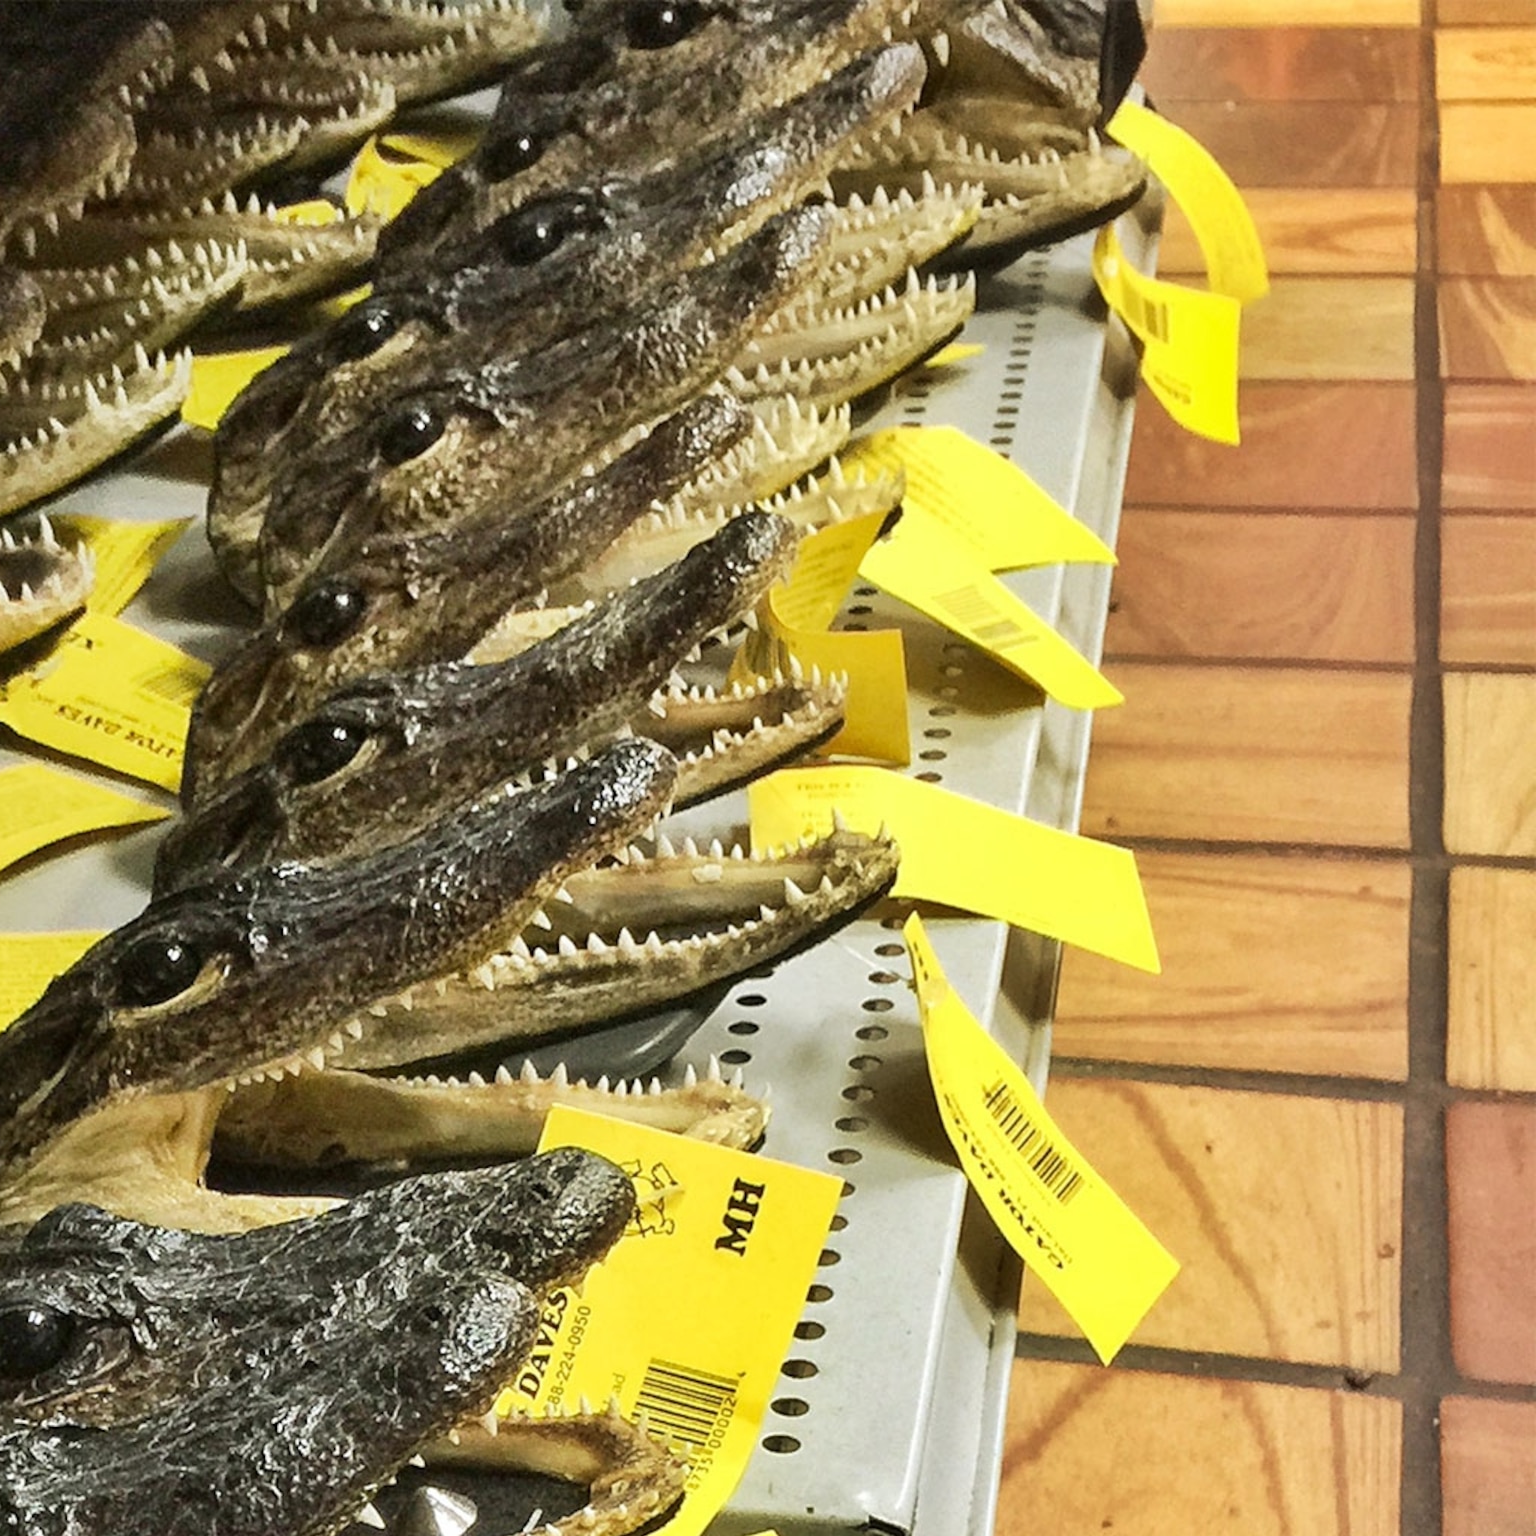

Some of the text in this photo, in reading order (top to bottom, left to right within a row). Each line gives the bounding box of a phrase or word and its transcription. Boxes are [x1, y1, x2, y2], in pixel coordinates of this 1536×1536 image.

[713, 1176, 766, 1257] MH
[997, 1187, 1064, 1270] GATOR
[513, 1284, 568, 1400] DAVES
[542, 1304, 592, 1412] 88-224-0950
